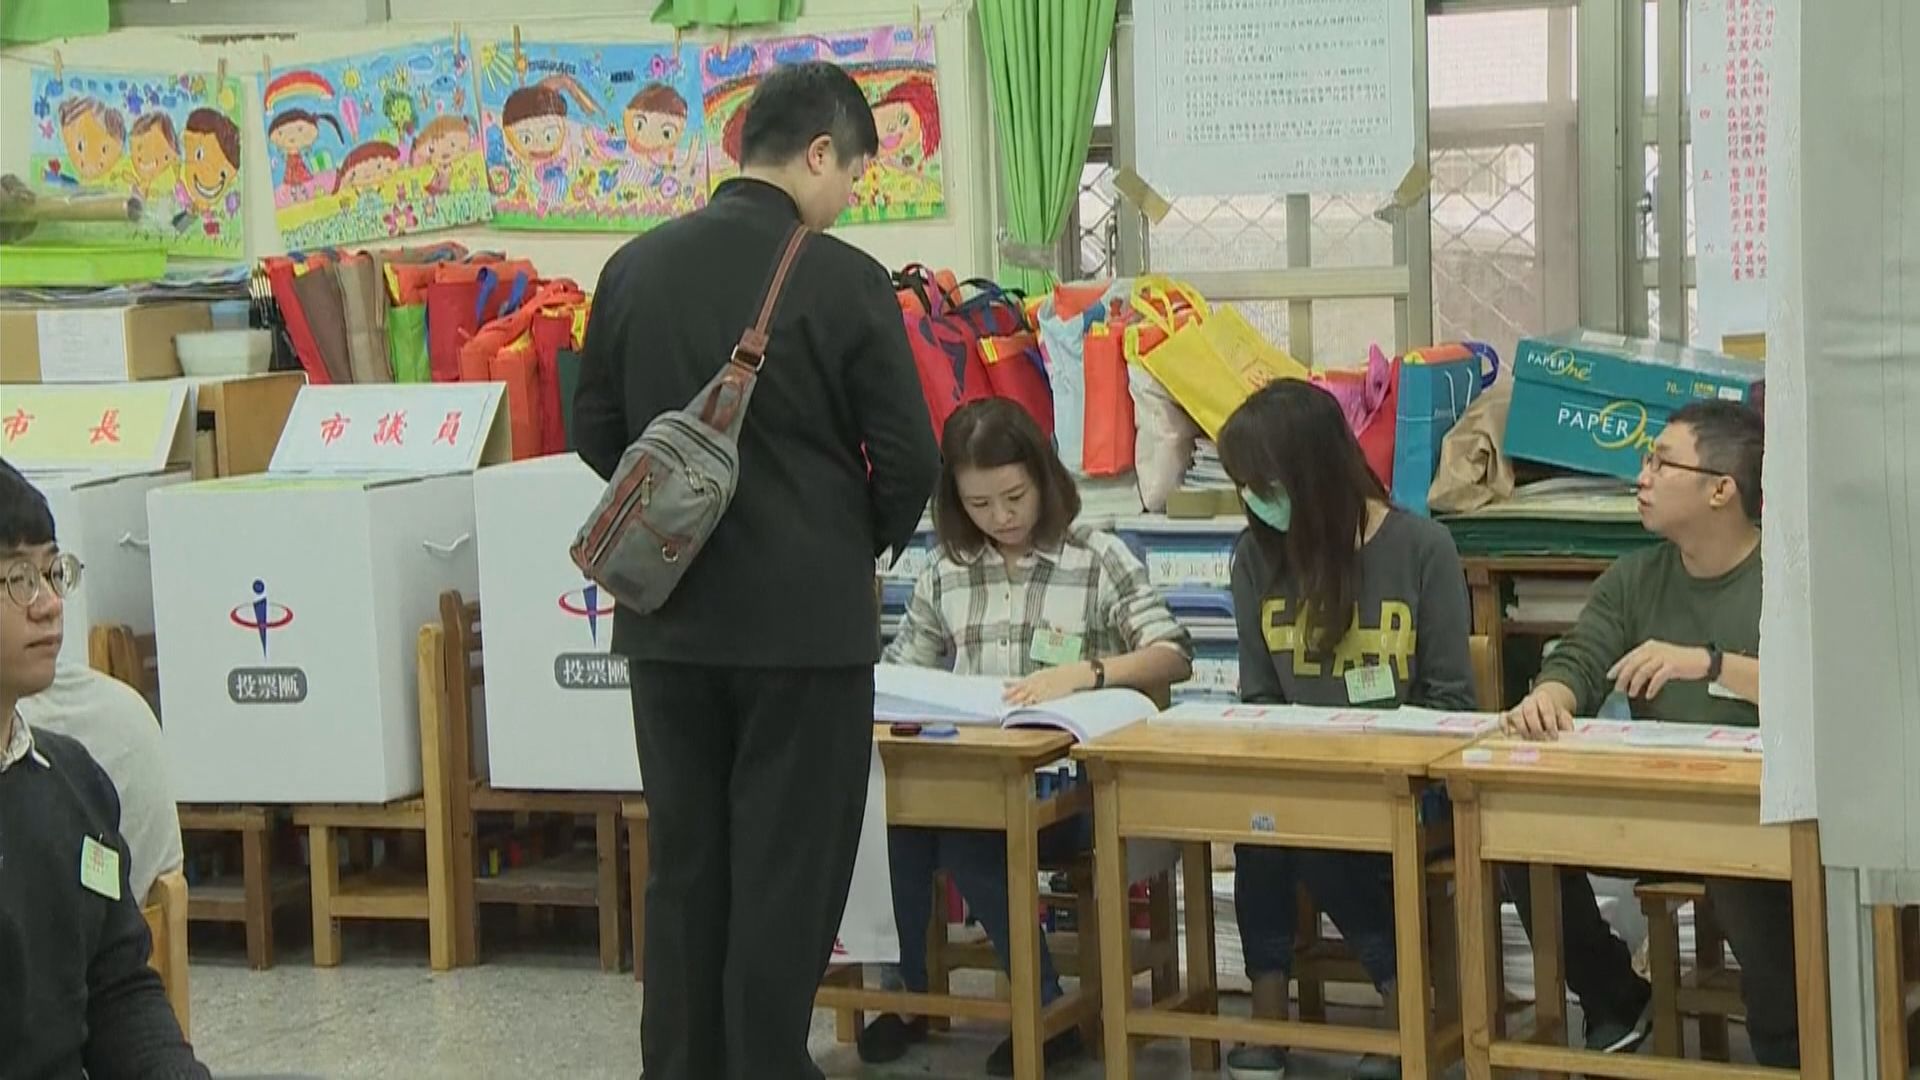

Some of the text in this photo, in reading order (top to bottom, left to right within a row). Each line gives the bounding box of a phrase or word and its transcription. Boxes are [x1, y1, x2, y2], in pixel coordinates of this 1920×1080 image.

[2, 407, 121, 444] 市長
[319, 410, 463, 447] 市議員
[1557, 400, 1656, 453] PAPER On
